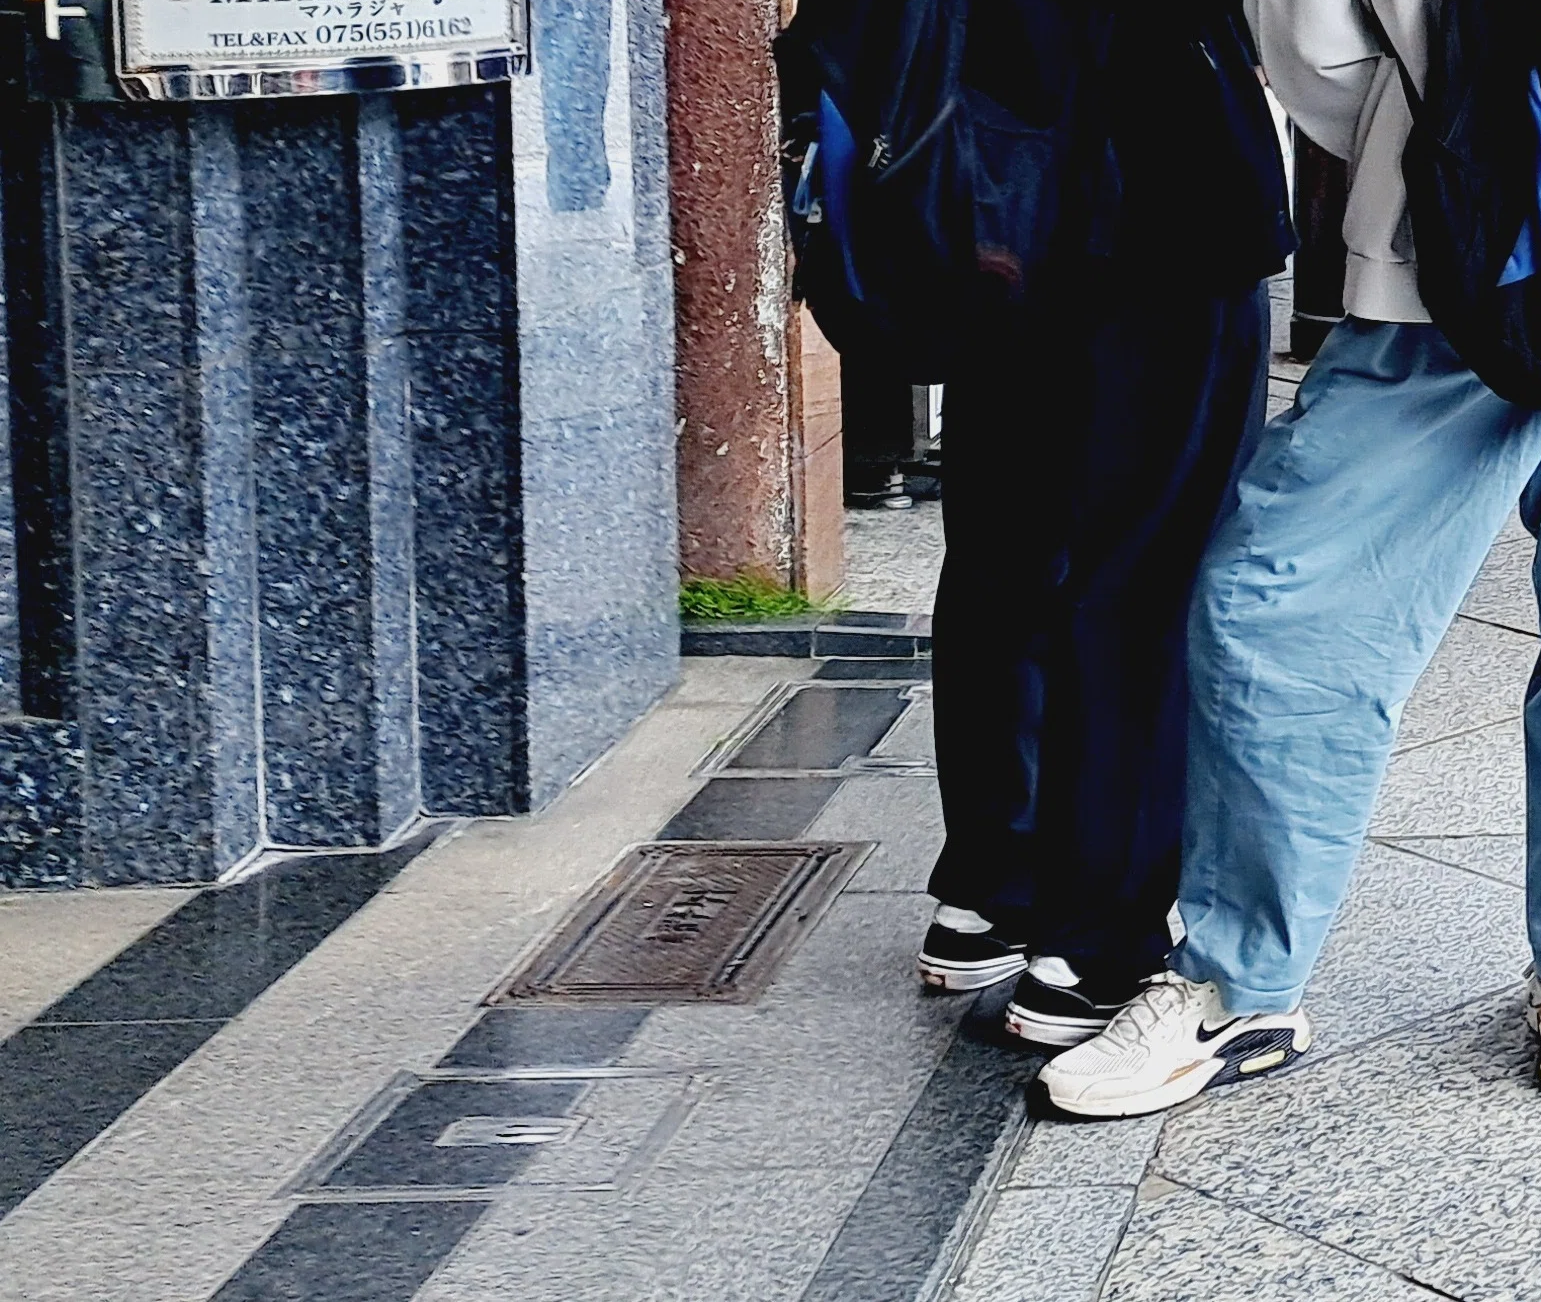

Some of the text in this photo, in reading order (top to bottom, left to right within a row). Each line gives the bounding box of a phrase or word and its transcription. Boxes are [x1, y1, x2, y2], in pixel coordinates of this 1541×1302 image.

[299, 0, 406, 18] マハラジャ
[208, 31, 306, 48] TEL&FAX
